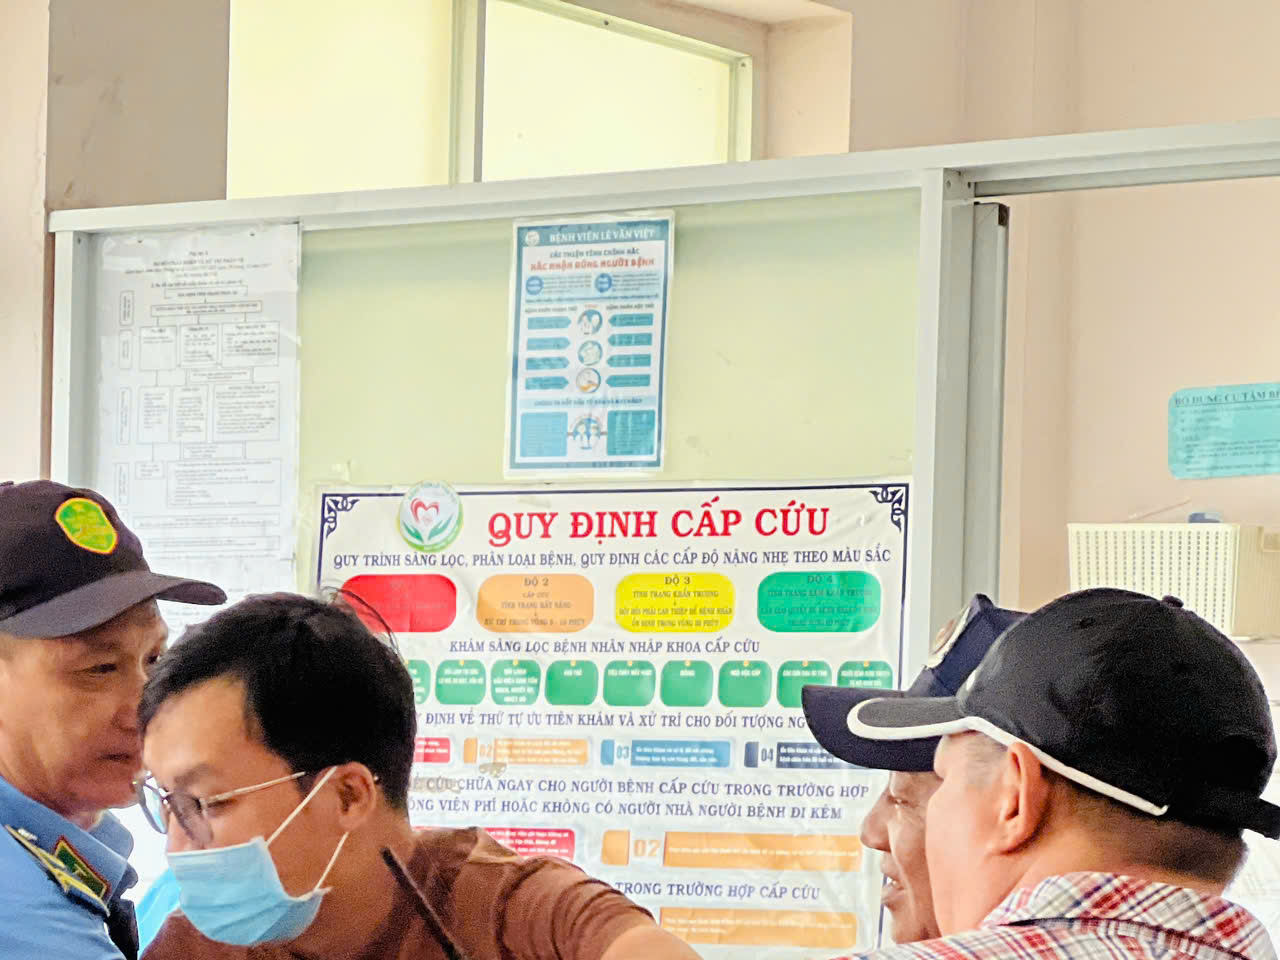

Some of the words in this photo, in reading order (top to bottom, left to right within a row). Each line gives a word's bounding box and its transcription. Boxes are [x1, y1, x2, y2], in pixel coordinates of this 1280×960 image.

[488, 511, 559, 547] QUY
[570, 510, 658, 545] ĐỊNH
[671, 496, 742, 538] CẤP
[754, 500, 830, 537] CỨU
[334, 554, 360, 570] QUY
[363, 551, 400, 566] TRÌNH
[440, 554, 468, 568] LỌC,
[472, 550, 504, 566] PHÂN
[508, 552, 536, 568] LOẠI
[539, 549, 576, 568] BỆNH,
[580, 552, 606, 568] QUY
[609, 552, 640, 567] ĐỊNH
[644, 548, 670, 565] CÁC
[673, 546, 698, 565] CẤP
[701, 548, 719, 566] ĐỘ
[723, 548, 758, 566] NẶNG
[762, 551, 790, 567] NHẸ
[794, 550, 828, 564] THEO
[832, 547, 862, 563] MÀU
[866, 543, 891, 562] SẮC
[542, 578, 549, 586] 2
[664, 574, 680, 586] ĐỘ
[684, 576, 690, 585] 3
[450, 639, 484, 652] KHÁM
[526, 641, 549, 655] LỌC
[554, 639, 587, 656] BỆNH
[592, 638, 625, 653] NHÂN
[630, 639, 662, 655] NHẬP
[666, 641, 702, 653] KHOA
[705, 636, 730, 653] CẤP
[734, 638, 760, 653] CỨU
[426, 712, 455, 726] ĐỊNH
[479, 710, 502, 725] THỨ
[508, 712, 522, 728] TỰ
[528, 712, 542, 726] ƯU
[546, 710, 574, 726] TIÊN
[578, 711, 614, 726] KHÁM
[619, 711, 634, 726] VÀ
[639, 712, 656, 726] XỬ
[660, 712, 681, 728] TRÍ
[686, 714, 711, 728] CHO
[716, 710, 737, 728] ĐỐI
[742, 713, 784, 731] TƯỢNG
[616, 745, 630, 759] 03
[761, 748, 774, 762] 04
[458, 777, 492, 792] CHỮA
[498, 780, 534, 792] NGAY
[538, 780, 566, 792] CHO
[572, 778, 613, 793] NGƯỜI
[618, 779, 654, 794] BỆNH
[659, 778, 687, 794] CẤP
[692, 780, 720, 796] CỨU
[724, 784, 772, 796] TRONG
[777, 781, 834, 798] TRƯỜNG
[840, 785, 870, 800] HỢP
[474, 797, 496, 812] PHÍ
[502, 800, 538, 814] HOẶC
[543, 800, 590, 814] KHÔNG
[595, 800, 613, 814] CÓ
[618, 802, 660, 816] NGƯỜI
[665, 801, 694, 816] NHÀ
[698, 802, 742, 817] NGƯỜI
[747, 803, 786, 820] BỆNH
[790, 806, 806, 818] ĐI
[634, 839, 661, 857] 02
[615, 881, 662, 895] TRONG
[668, 880, 724, 896] TRƯỜNG
[728, 884, 756, 899] HỢP
[760, 882, 788, 899] CẤP
[792, 884, 820, 900] CỨU
